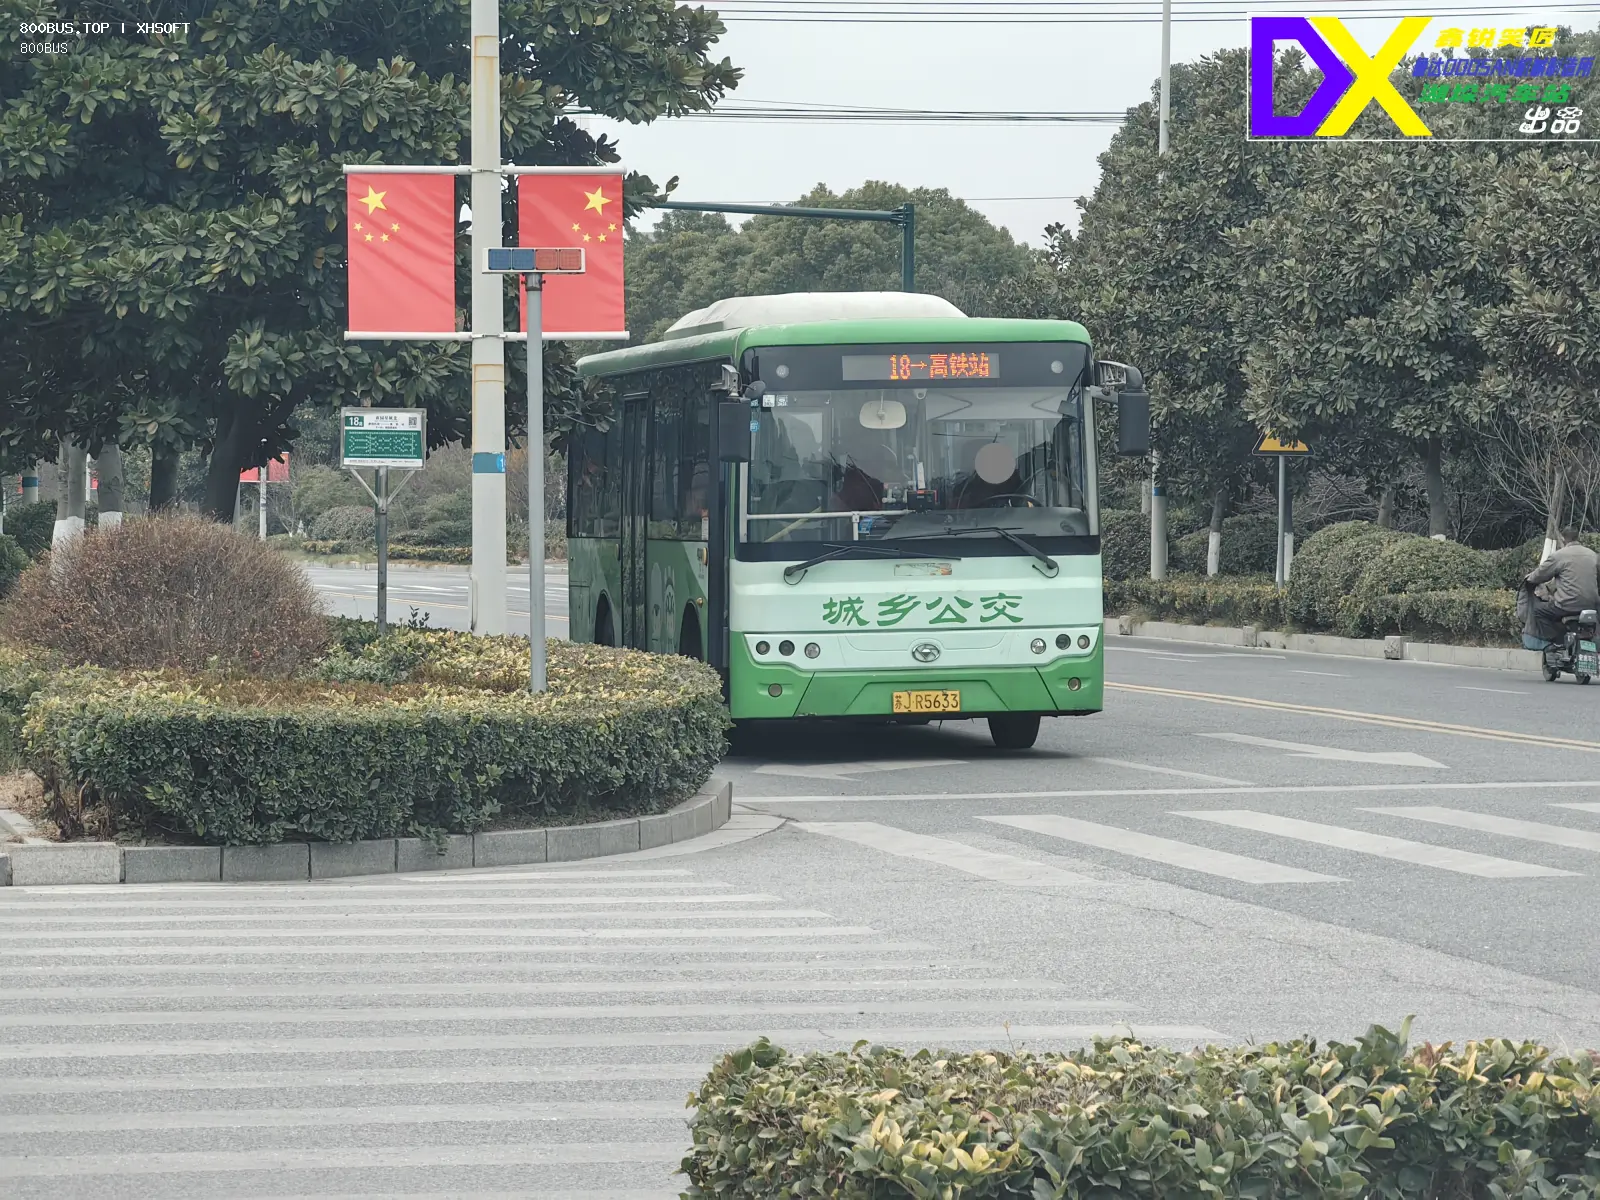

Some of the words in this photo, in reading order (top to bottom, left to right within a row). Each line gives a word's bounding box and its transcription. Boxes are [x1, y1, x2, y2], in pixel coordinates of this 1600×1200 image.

[889, 354, 912, 380] 18
[929, 352, 990, 378] 高铁站
[822, 592, 1024, 627] 城乡公交
